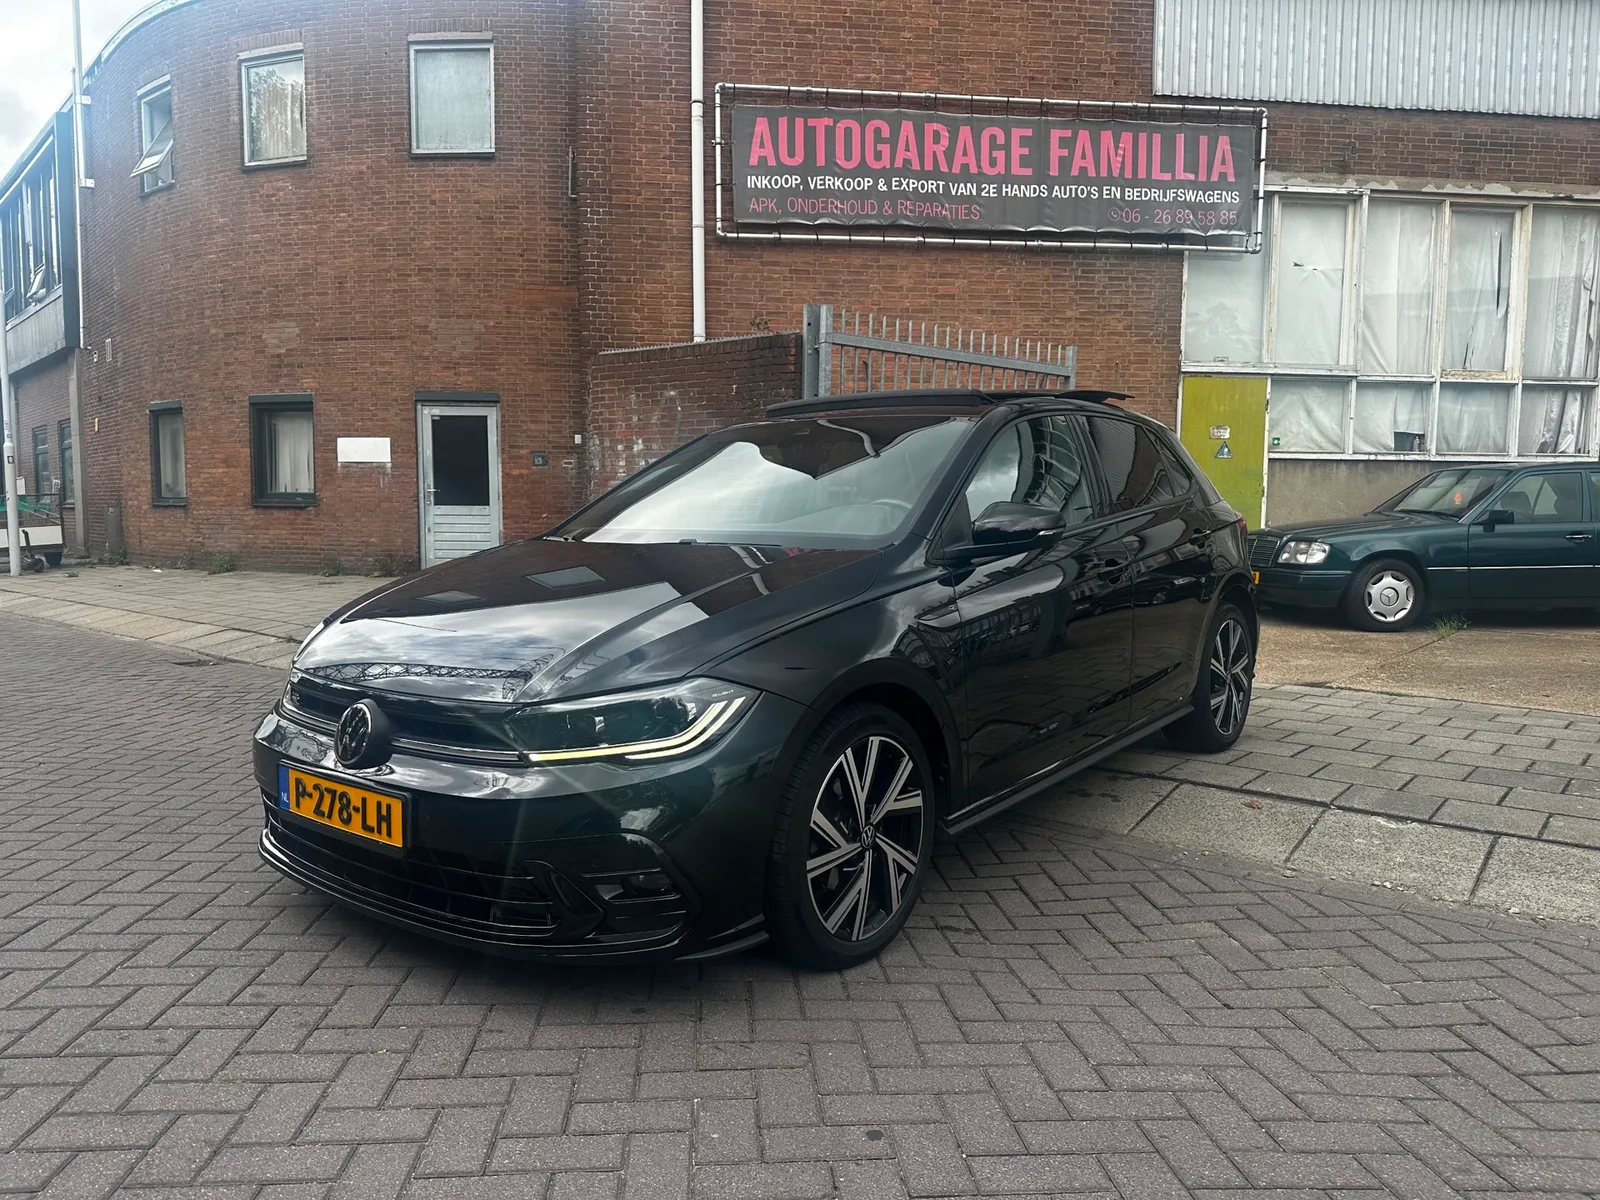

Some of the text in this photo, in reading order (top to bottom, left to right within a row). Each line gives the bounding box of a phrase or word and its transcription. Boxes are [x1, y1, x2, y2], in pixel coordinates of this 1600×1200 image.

[749, 117, 1236, 182] AUTOGARAGE FAMILLIA
[747, 174, 1240, 204] INKOOP, VERKOOP & EXPORT VAN 2E HANDS AUTO'S EN BEDRIJFSWAGENS
[749, 197, 980, 220] APK, ONDERHOUD & REPARATIES
[1122, 208, 1141, 223] 06
[1153, 209, 1171, 224] 26
[1175, 208, 1193, 224] 89
[1197, 210, 1216, 226] 58
[1219, 210, 1237, 226] 85
[281, 792, 289, 803] NL
[295, 777, 392, 838] P-278-LH
